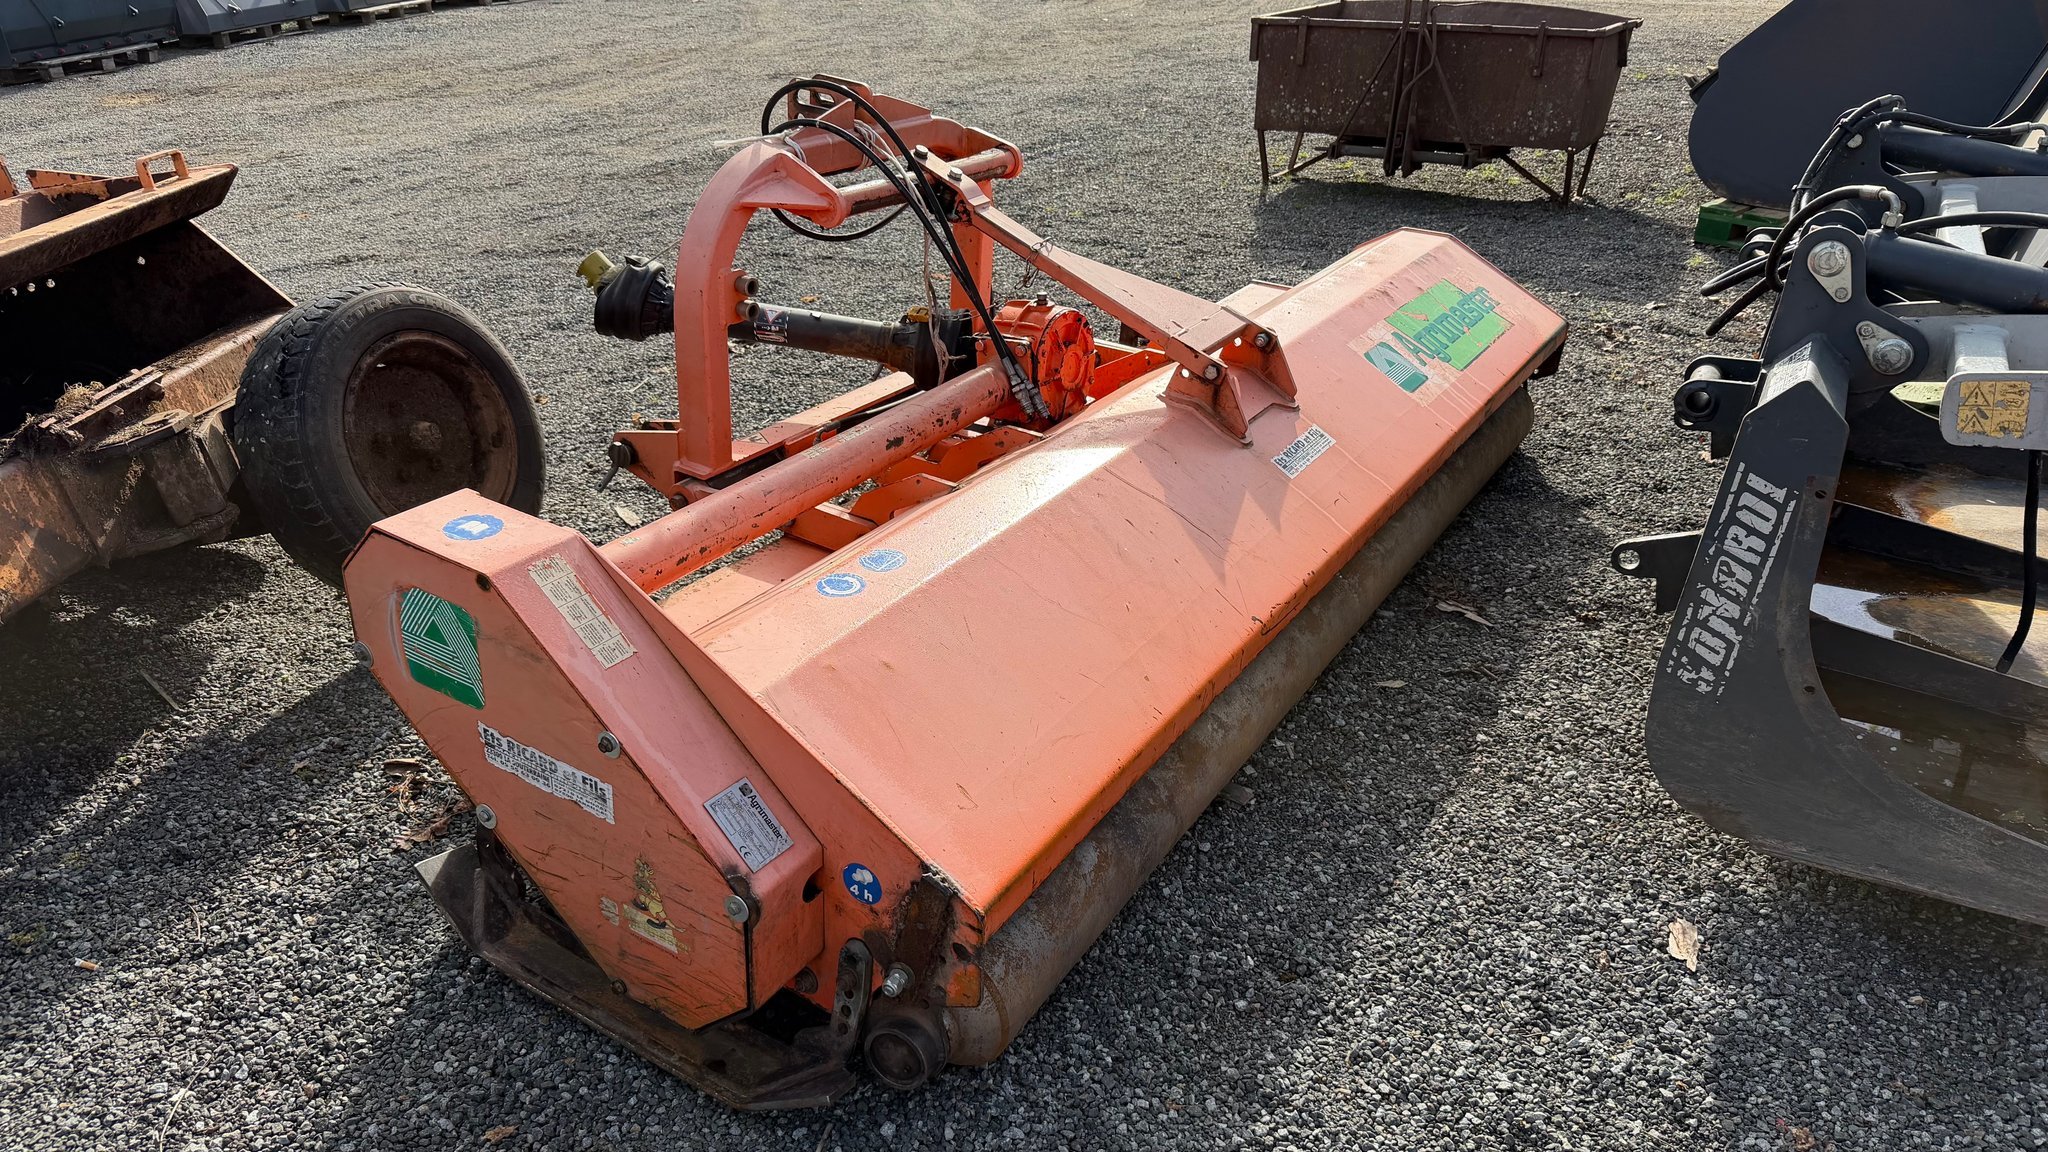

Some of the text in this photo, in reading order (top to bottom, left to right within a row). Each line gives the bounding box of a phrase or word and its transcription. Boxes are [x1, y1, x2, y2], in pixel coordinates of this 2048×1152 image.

[1283, 440, 1305, 458] RICARD
[483, 727, 503, 747] Ets
[507, 739, 558, 773] RICARD
[581, 775, 607, 798] Fils
[747, 795, 783, 839] Agrimaster
[850, 885, 873, 902] 4 h
